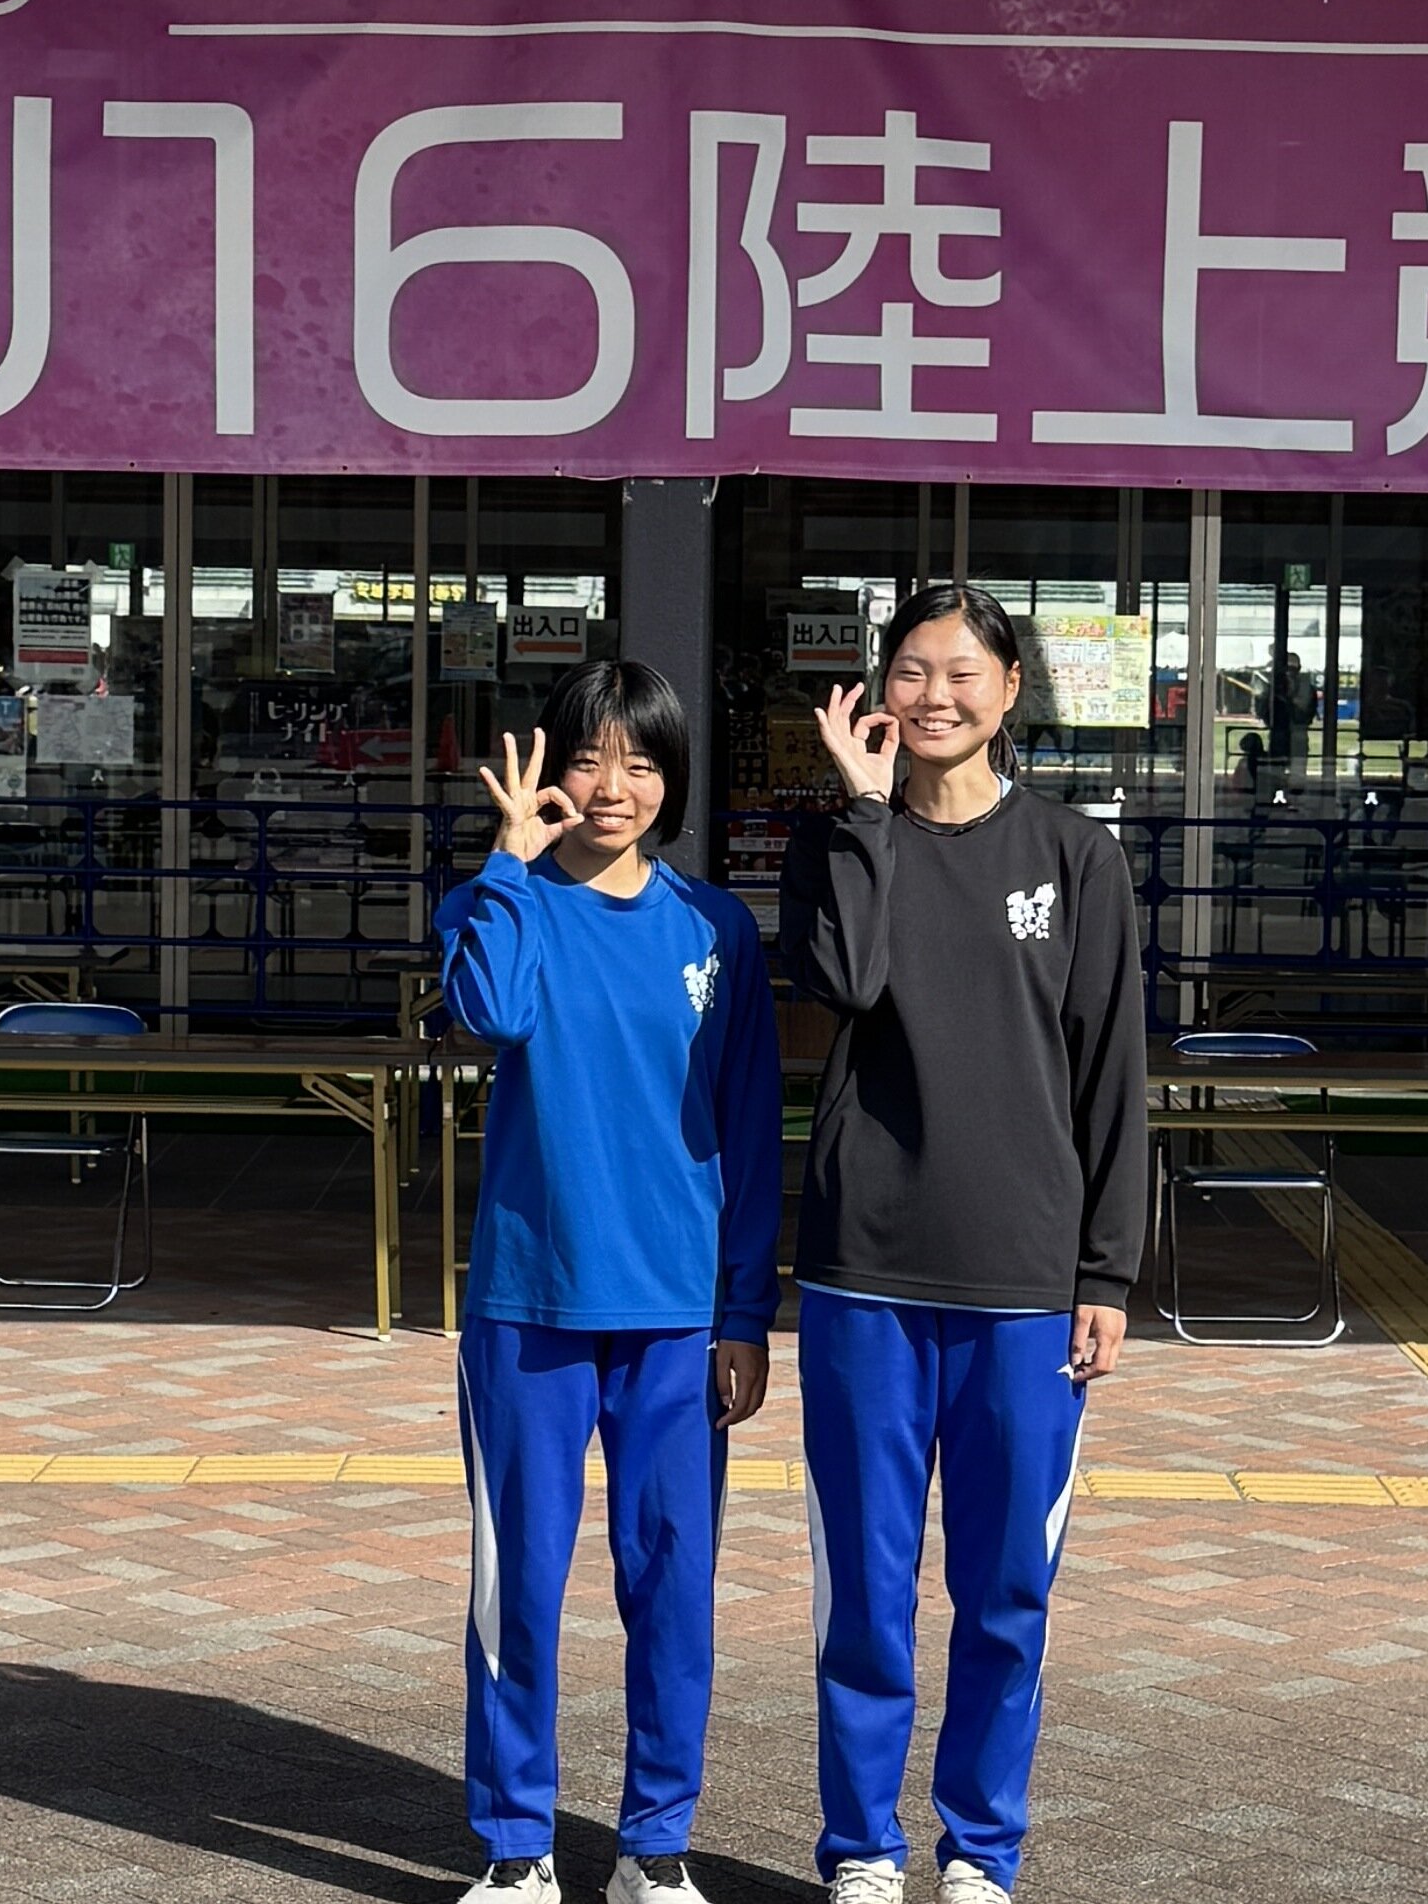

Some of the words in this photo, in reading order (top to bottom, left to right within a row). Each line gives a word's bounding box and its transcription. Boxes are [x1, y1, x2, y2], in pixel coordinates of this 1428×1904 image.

[513, 614, 579, 637] 出入口
[793, 623, 859, 645] 出入口
